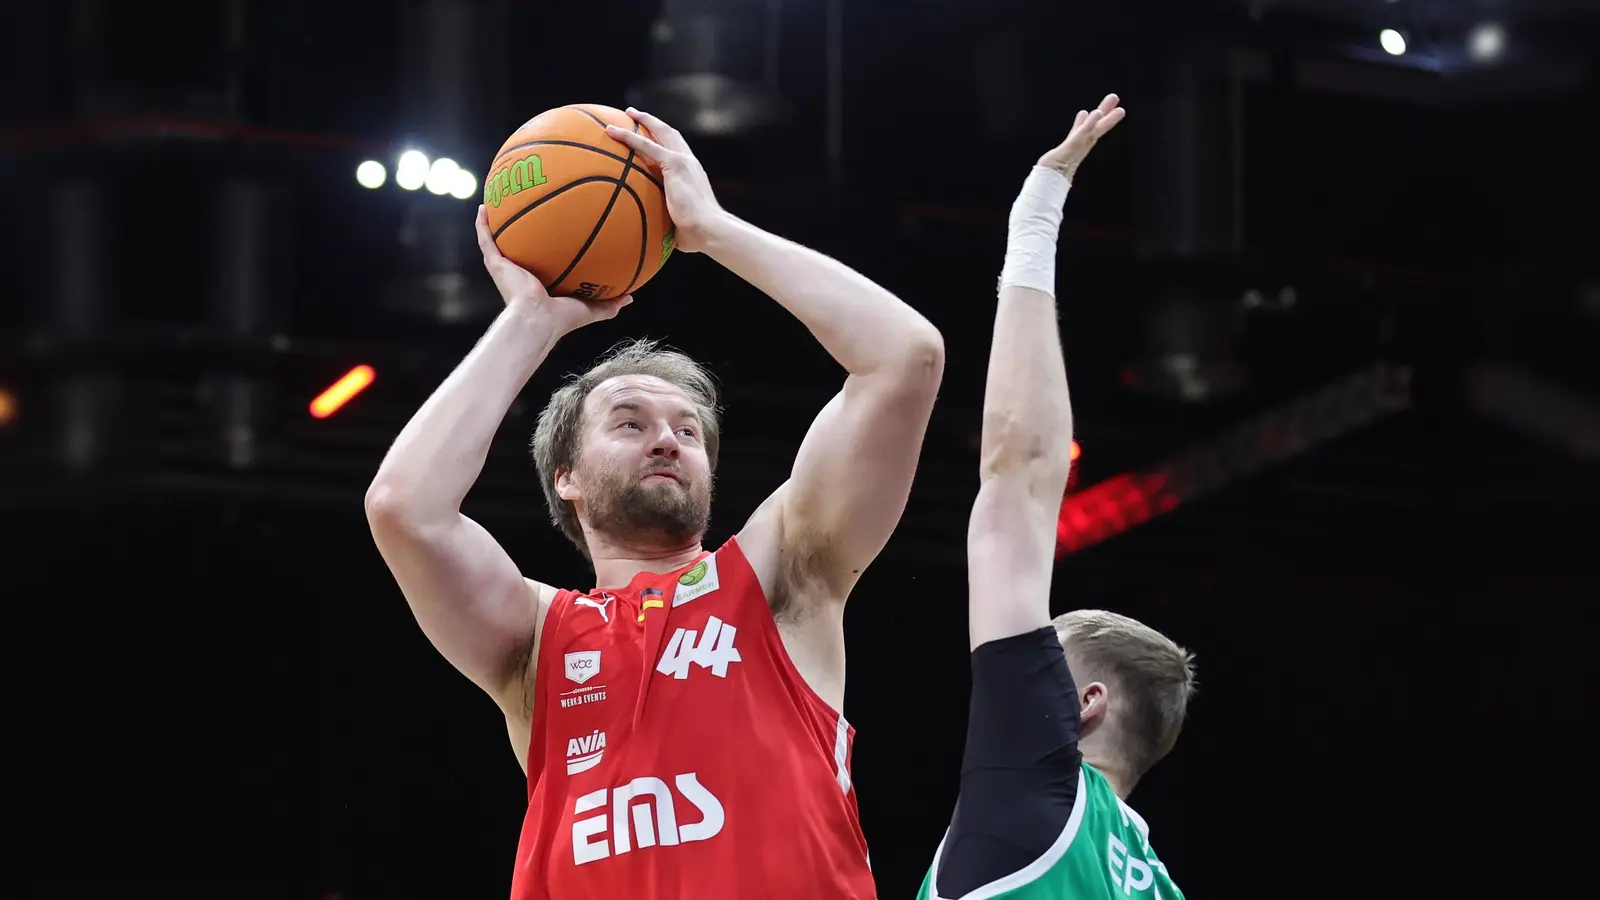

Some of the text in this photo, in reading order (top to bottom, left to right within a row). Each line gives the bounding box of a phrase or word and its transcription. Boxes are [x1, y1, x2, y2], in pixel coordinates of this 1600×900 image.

[656, 615, 742, 679] 44
[583, 691, 606, 704] EVENTS
[572, 772, 725, 866] EMS
[1108, 831, 1161, 900] EP
